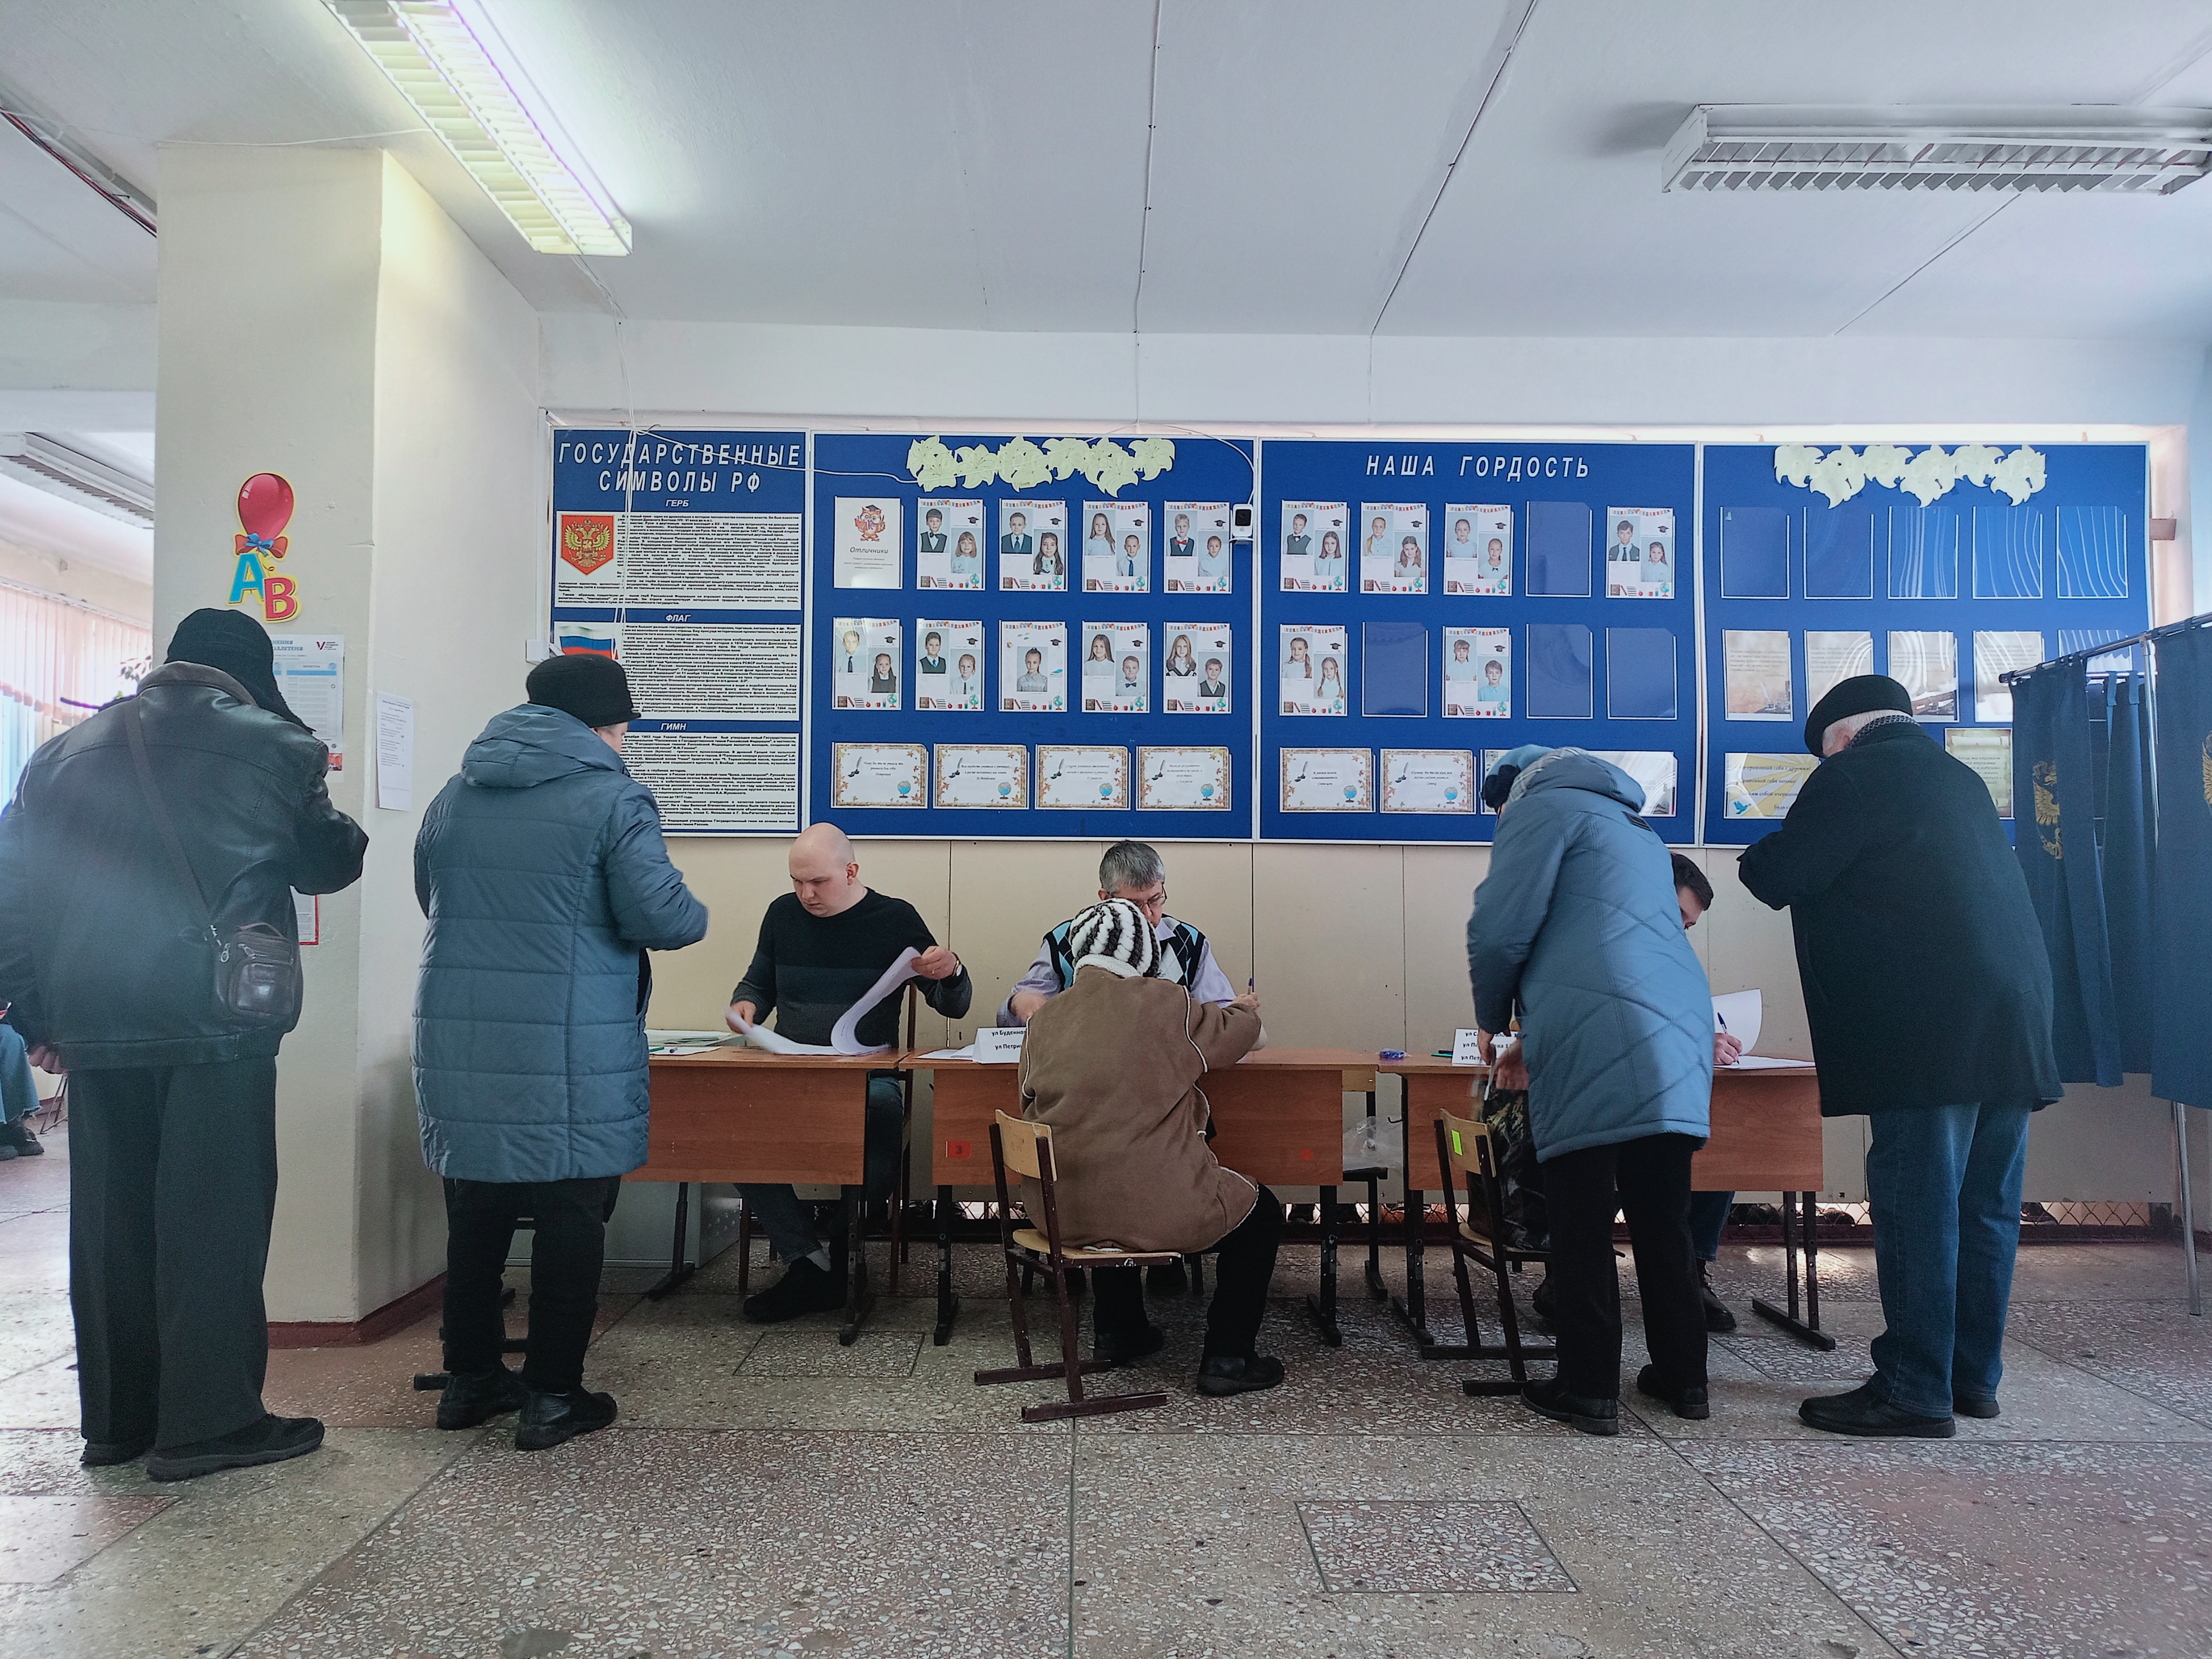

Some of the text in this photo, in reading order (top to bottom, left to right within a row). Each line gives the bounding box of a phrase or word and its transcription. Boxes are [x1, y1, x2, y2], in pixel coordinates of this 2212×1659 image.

[558, 442, 800, 468] ГОСУДАРСТВЕННЫЕ
[1365, 455, 1589, 482] НАША ГОРДОСТЬ
[599, 470, 761, 493] СИМВОЛЫ РФ
[665, 614, 691, 622] ФЛАГ
[660, 723, 687, 731] ГИМН
[956, 1145, 963, 1155] 3
